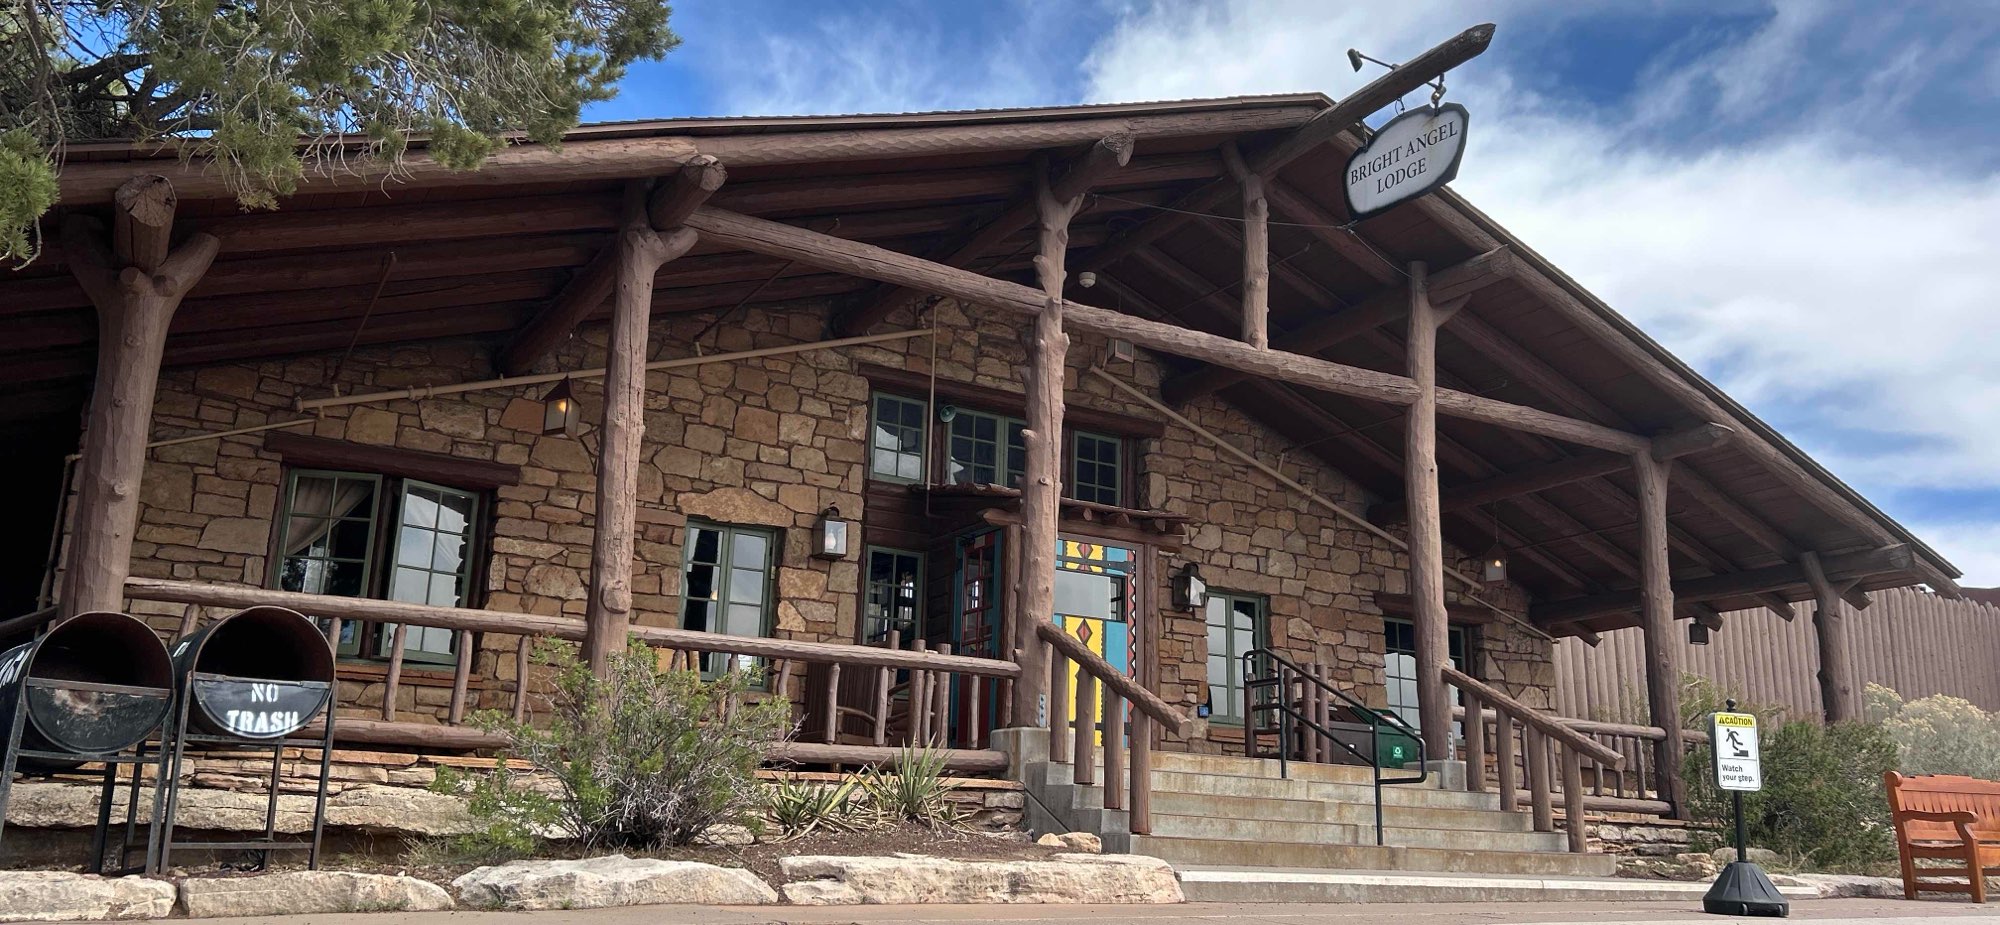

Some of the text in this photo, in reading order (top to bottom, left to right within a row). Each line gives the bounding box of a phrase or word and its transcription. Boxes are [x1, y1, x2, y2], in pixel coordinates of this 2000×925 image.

[1350, 121, 1458, 185] BRIGHT ANGEL
[1376, 158, 1427, 194] LODGE
[251, 683, 279, 703] NO
[226, 710, 299, 733] TRASH
[1725, 716, 1753, 726] CAUTION
[1721, 764, 1743, 772] Watch
[1722, 774, 1754, 783] your step.
